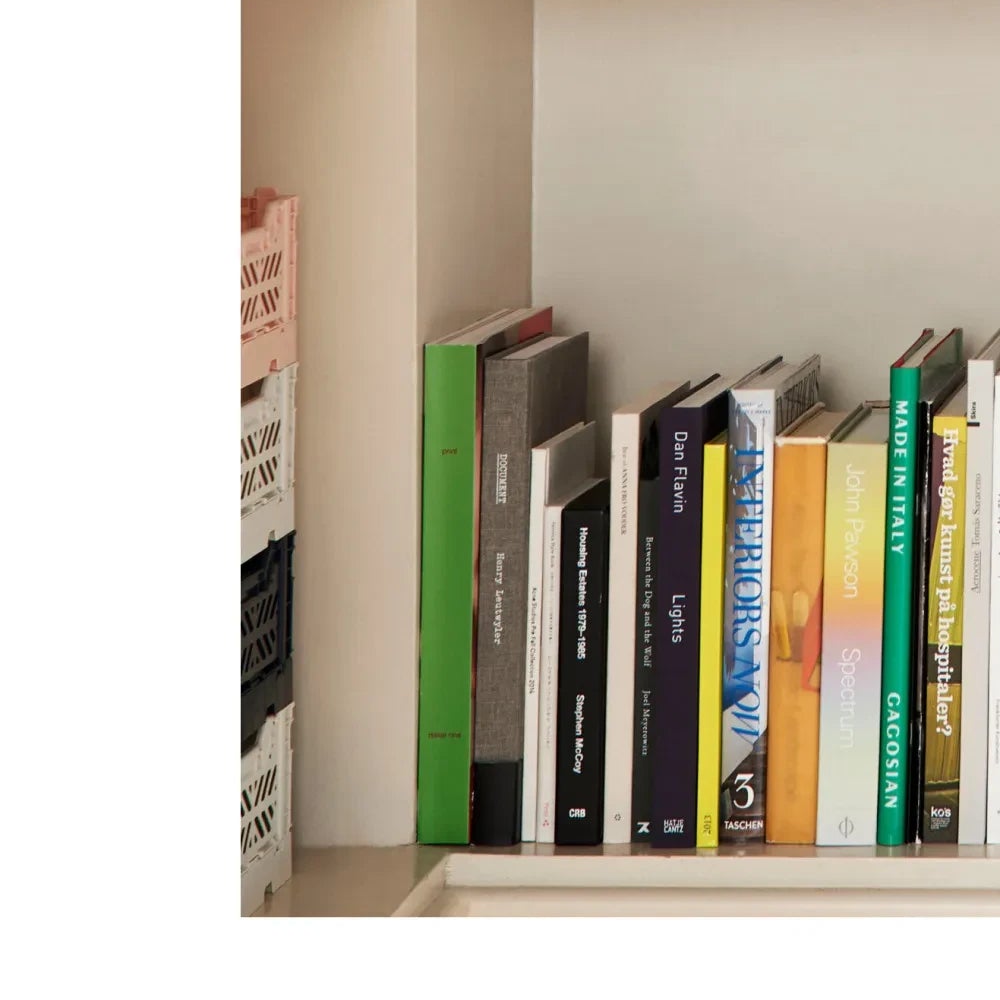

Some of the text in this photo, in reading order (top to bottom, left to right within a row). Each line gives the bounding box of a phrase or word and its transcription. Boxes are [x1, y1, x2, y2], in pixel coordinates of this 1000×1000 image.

[497, 453, 508, 504] DOCUMENT
[674, 431, 688, 513] Dan Flavin
[891, 400, 909, 555] MADE IN ITALY
[972, 473, 981, 515] Saraceno
[577, 527, 588, 567] Housing
[732, 449, 764, 646] INTERIORS
[844, 463, 864, 598] John Pawson
[493, 553, 505, 645] Henry Leutwyler
[577, 569, 588, 606] Estates
[643, 536, 654, 667] Between the Dog and the Wolf
[934, 428, 959, 736] Hvad gør kunst på hospitaler?
[669, 594, 685, 643] Lights
[642, 689, 652, 706] Joel
[731, 659, 761, 743] NOW
[837, 648, 862, 749] Spectrum
[572, 694, 585, 774] Stephen McCoy
[884, 692, 901, 808] GAGOSIAN
[569, 808, 586, 818] CRB
[663, 819, 684, 827] HATJE
[733, 773, 755, 808] 3
[663, 826, 684, 834] CANTZ
[724, 820, 763, 830] TASCHEN
